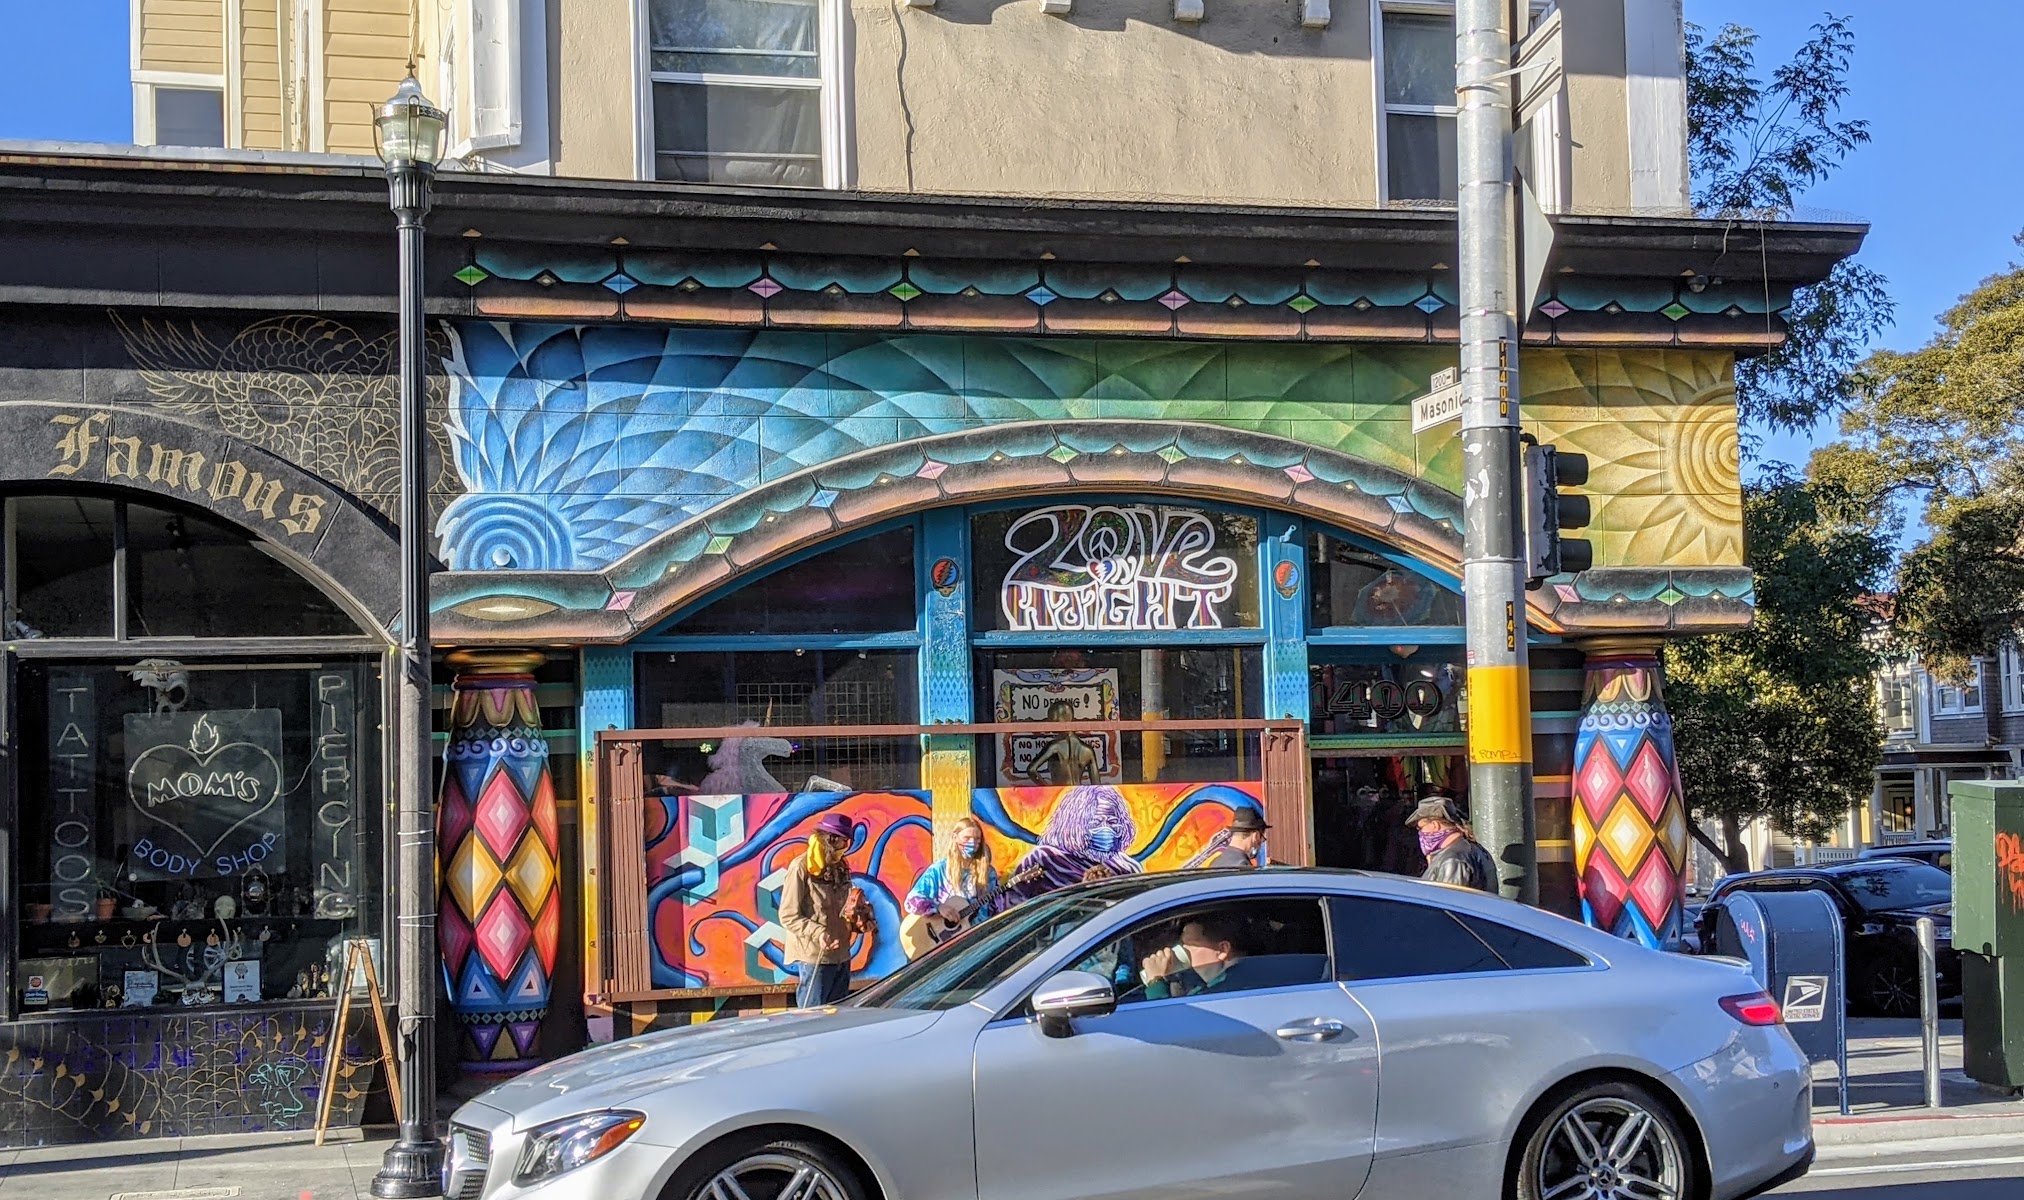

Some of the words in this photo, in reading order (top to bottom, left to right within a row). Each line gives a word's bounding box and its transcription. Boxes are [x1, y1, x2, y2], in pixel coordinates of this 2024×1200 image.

[47, 411, 327, 536] Famous
[1506, 604, 1515, 648] 142
[1022, 694, 1040, 710] NO
[1309, 680, 1442, 718] 1400
[1018, 741, 1033, 749] NO
[1019, 754, 1032, 763] NO
[55, 687, 90, 915] TATTOOS
[147, 771, 260, 807] MOM'S
[318, 675, 352, 919] PIERCING
[133, 838, 200, 875] BODY
[216, 832, 277, 875] SHOP
